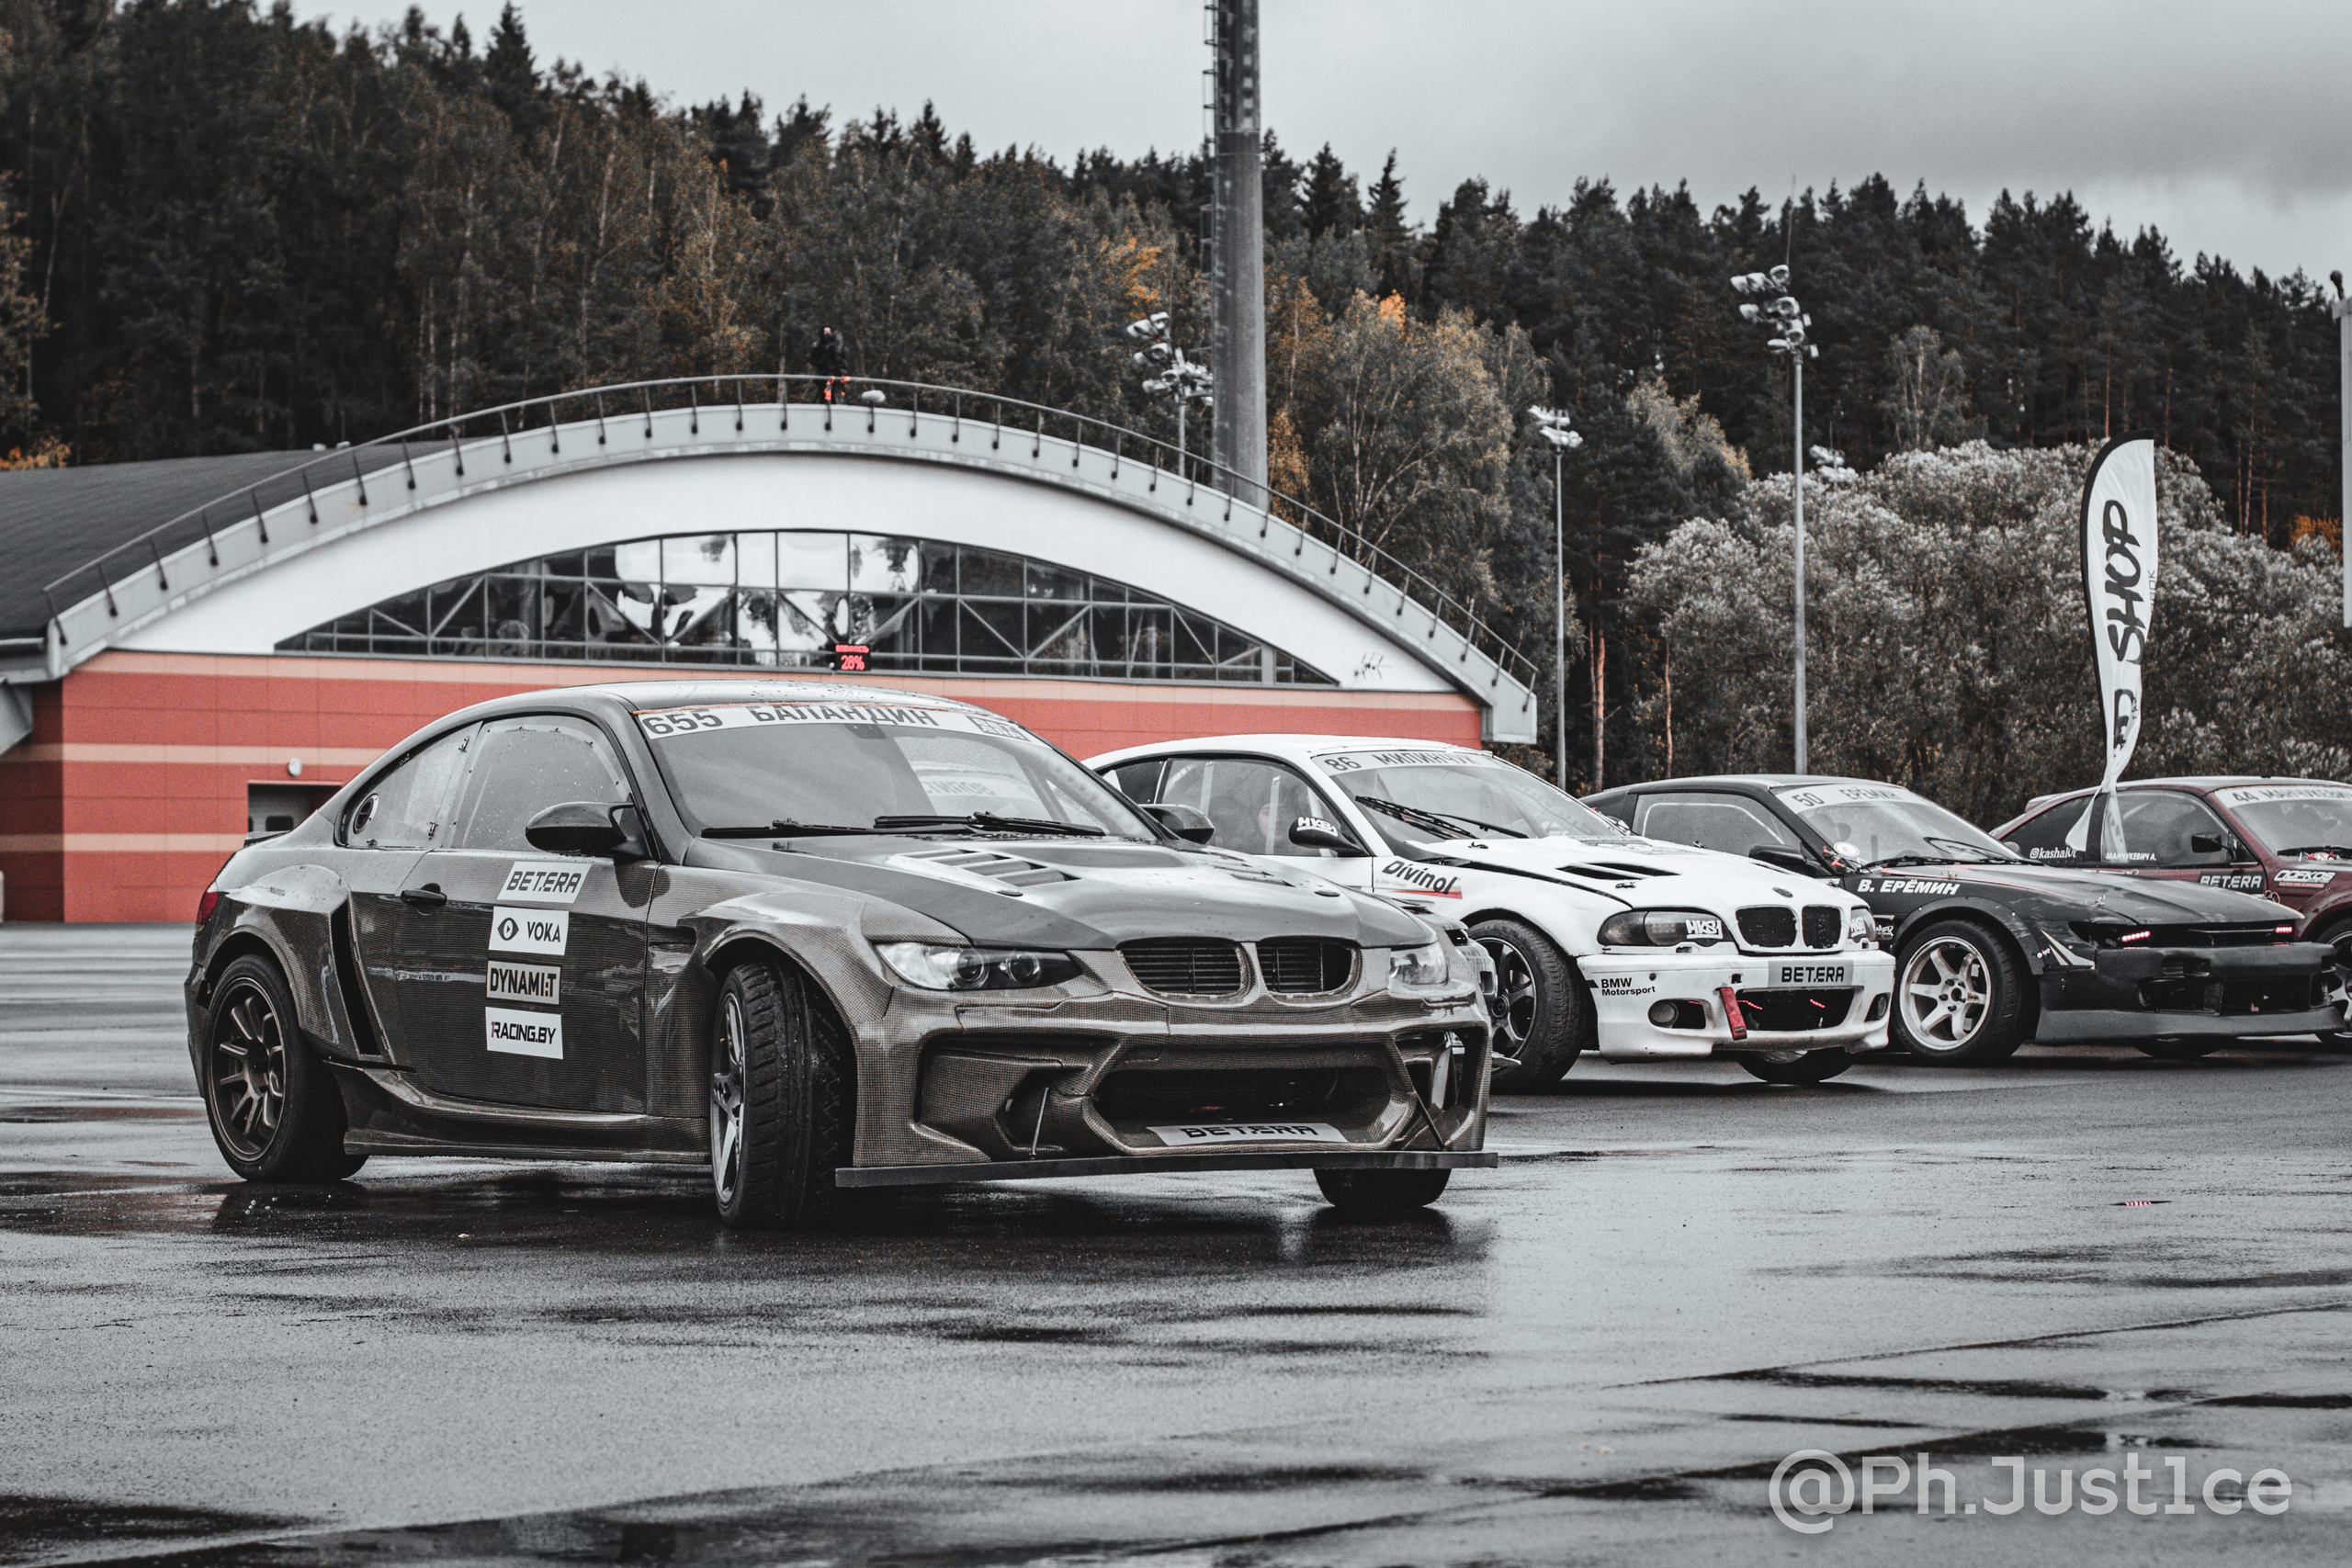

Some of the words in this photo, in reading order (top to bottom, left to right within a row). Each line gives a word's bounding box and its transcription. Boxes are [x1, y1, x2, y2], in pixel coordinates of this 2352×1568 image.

[641, 707, 723, 735] 655
[745, 705, 939, 726] БАЛАНДИН
[1324, 756, 1362, 771] 86
[1792, 793, 1825, 807] 50
[2232, 791, 2259, 802] 44
[1382, 860, 1458, 895] Divinol
[1880, 879, 1961, 896] ЕРЁМИН
[526, 920, 561, 942] VOKA
[1600, 977, 1632, 988] BMW
[1601, 986, 1656, 997] Motorsport
